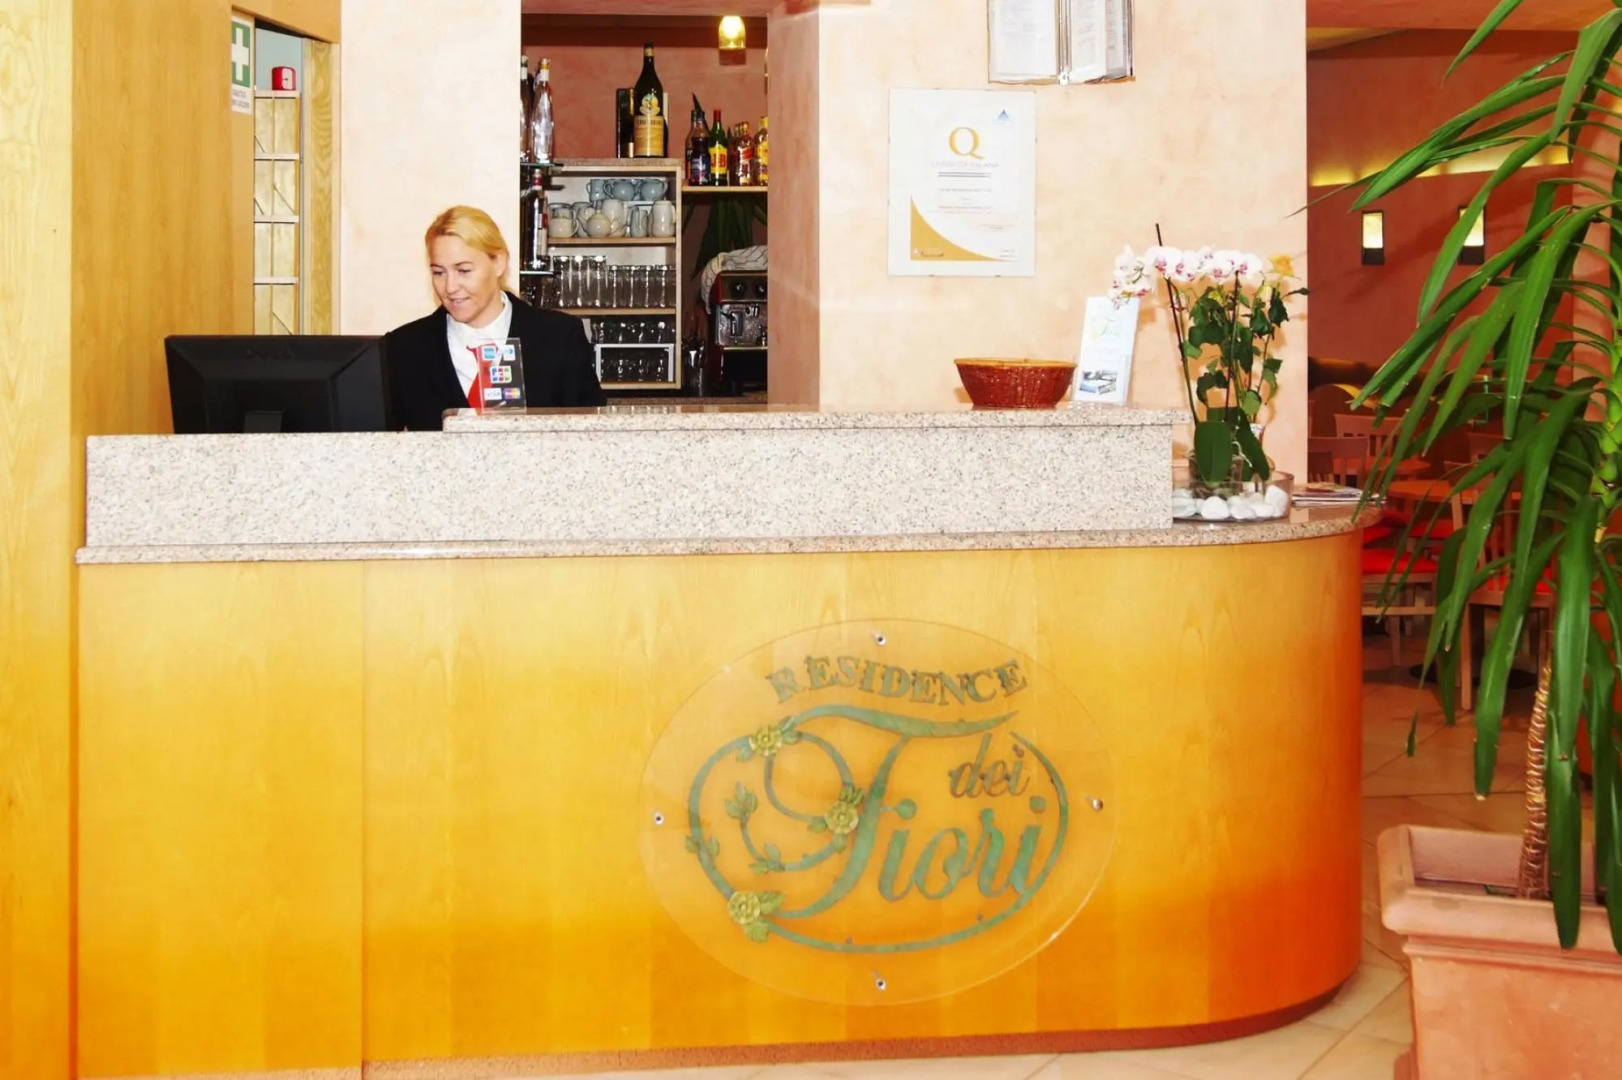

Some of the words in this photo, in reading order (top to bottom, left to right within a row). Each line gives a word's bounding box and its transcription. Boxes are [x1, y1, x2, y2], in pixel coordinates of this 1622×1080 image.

[950, 127, 983, 160] Q
[766, 656, 1027, 704] RESIDENCE
[949, 732, 1031, 798] dei
[782, 706, 1044, 916] Fiori
